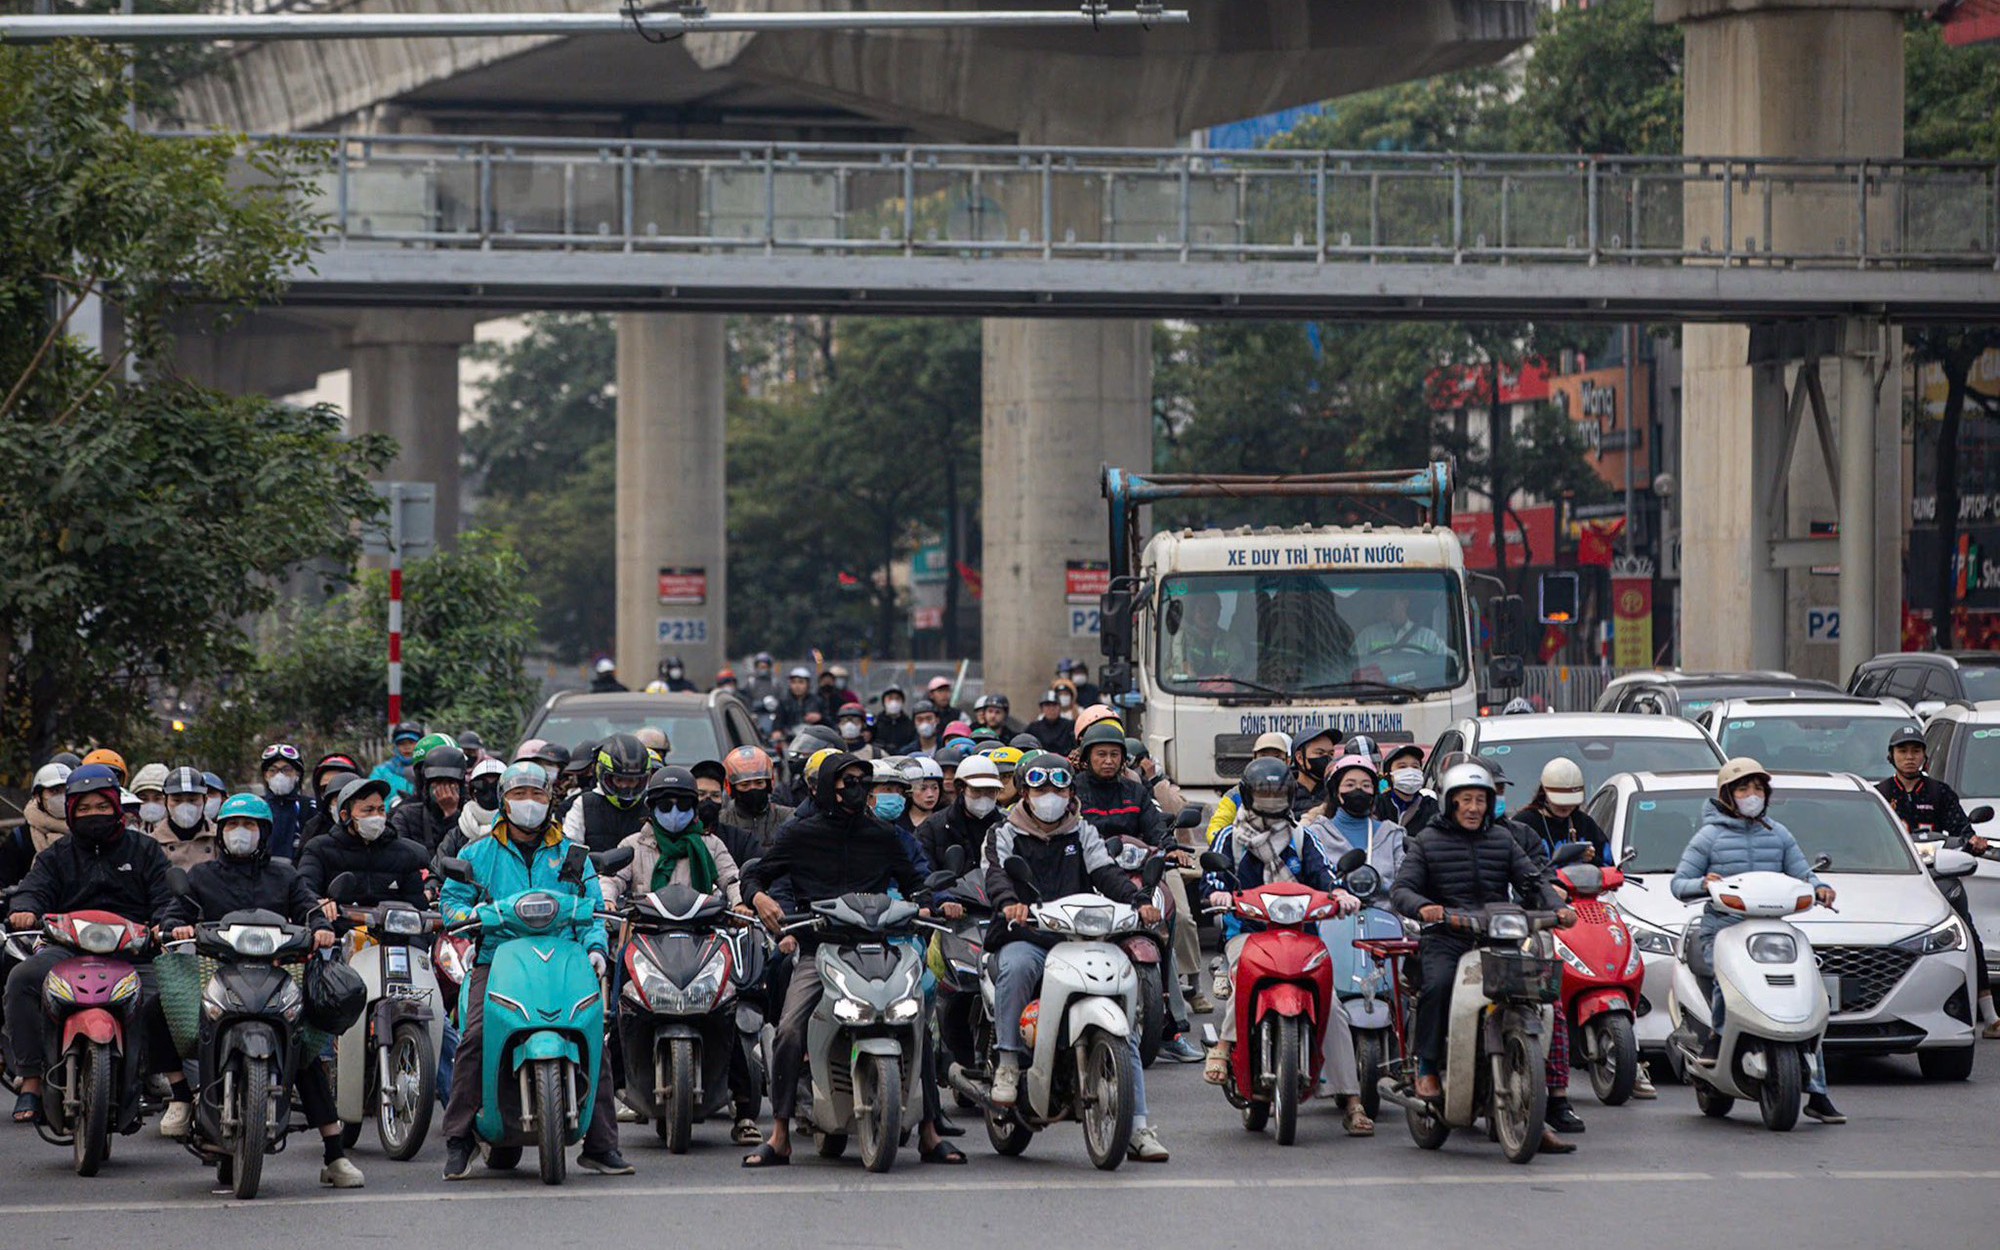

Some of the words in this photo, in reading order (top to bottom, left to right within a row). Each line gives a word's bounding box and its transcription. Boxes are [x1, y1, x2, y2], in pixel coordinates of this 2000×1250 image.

[1582, 380, 1614, 428] Wang
[1914, 496, 1936, 519] RUNG
[1958, 495, 1988, 519] APTOP
[1227, 549, 1247, 566] XE
[1251, 549, 1280, 566] DUY
[1285, 545, 1308, 565] TRÌ
[1313, 543, 1360, 565] THOÁT
[1364, 543, 1405, 564] NƯỚC
[1072, 610, 1100, 634] P2
[1808, 611, 1840, 639] P2
[1240, 712, 1266, 734] CÔNG
